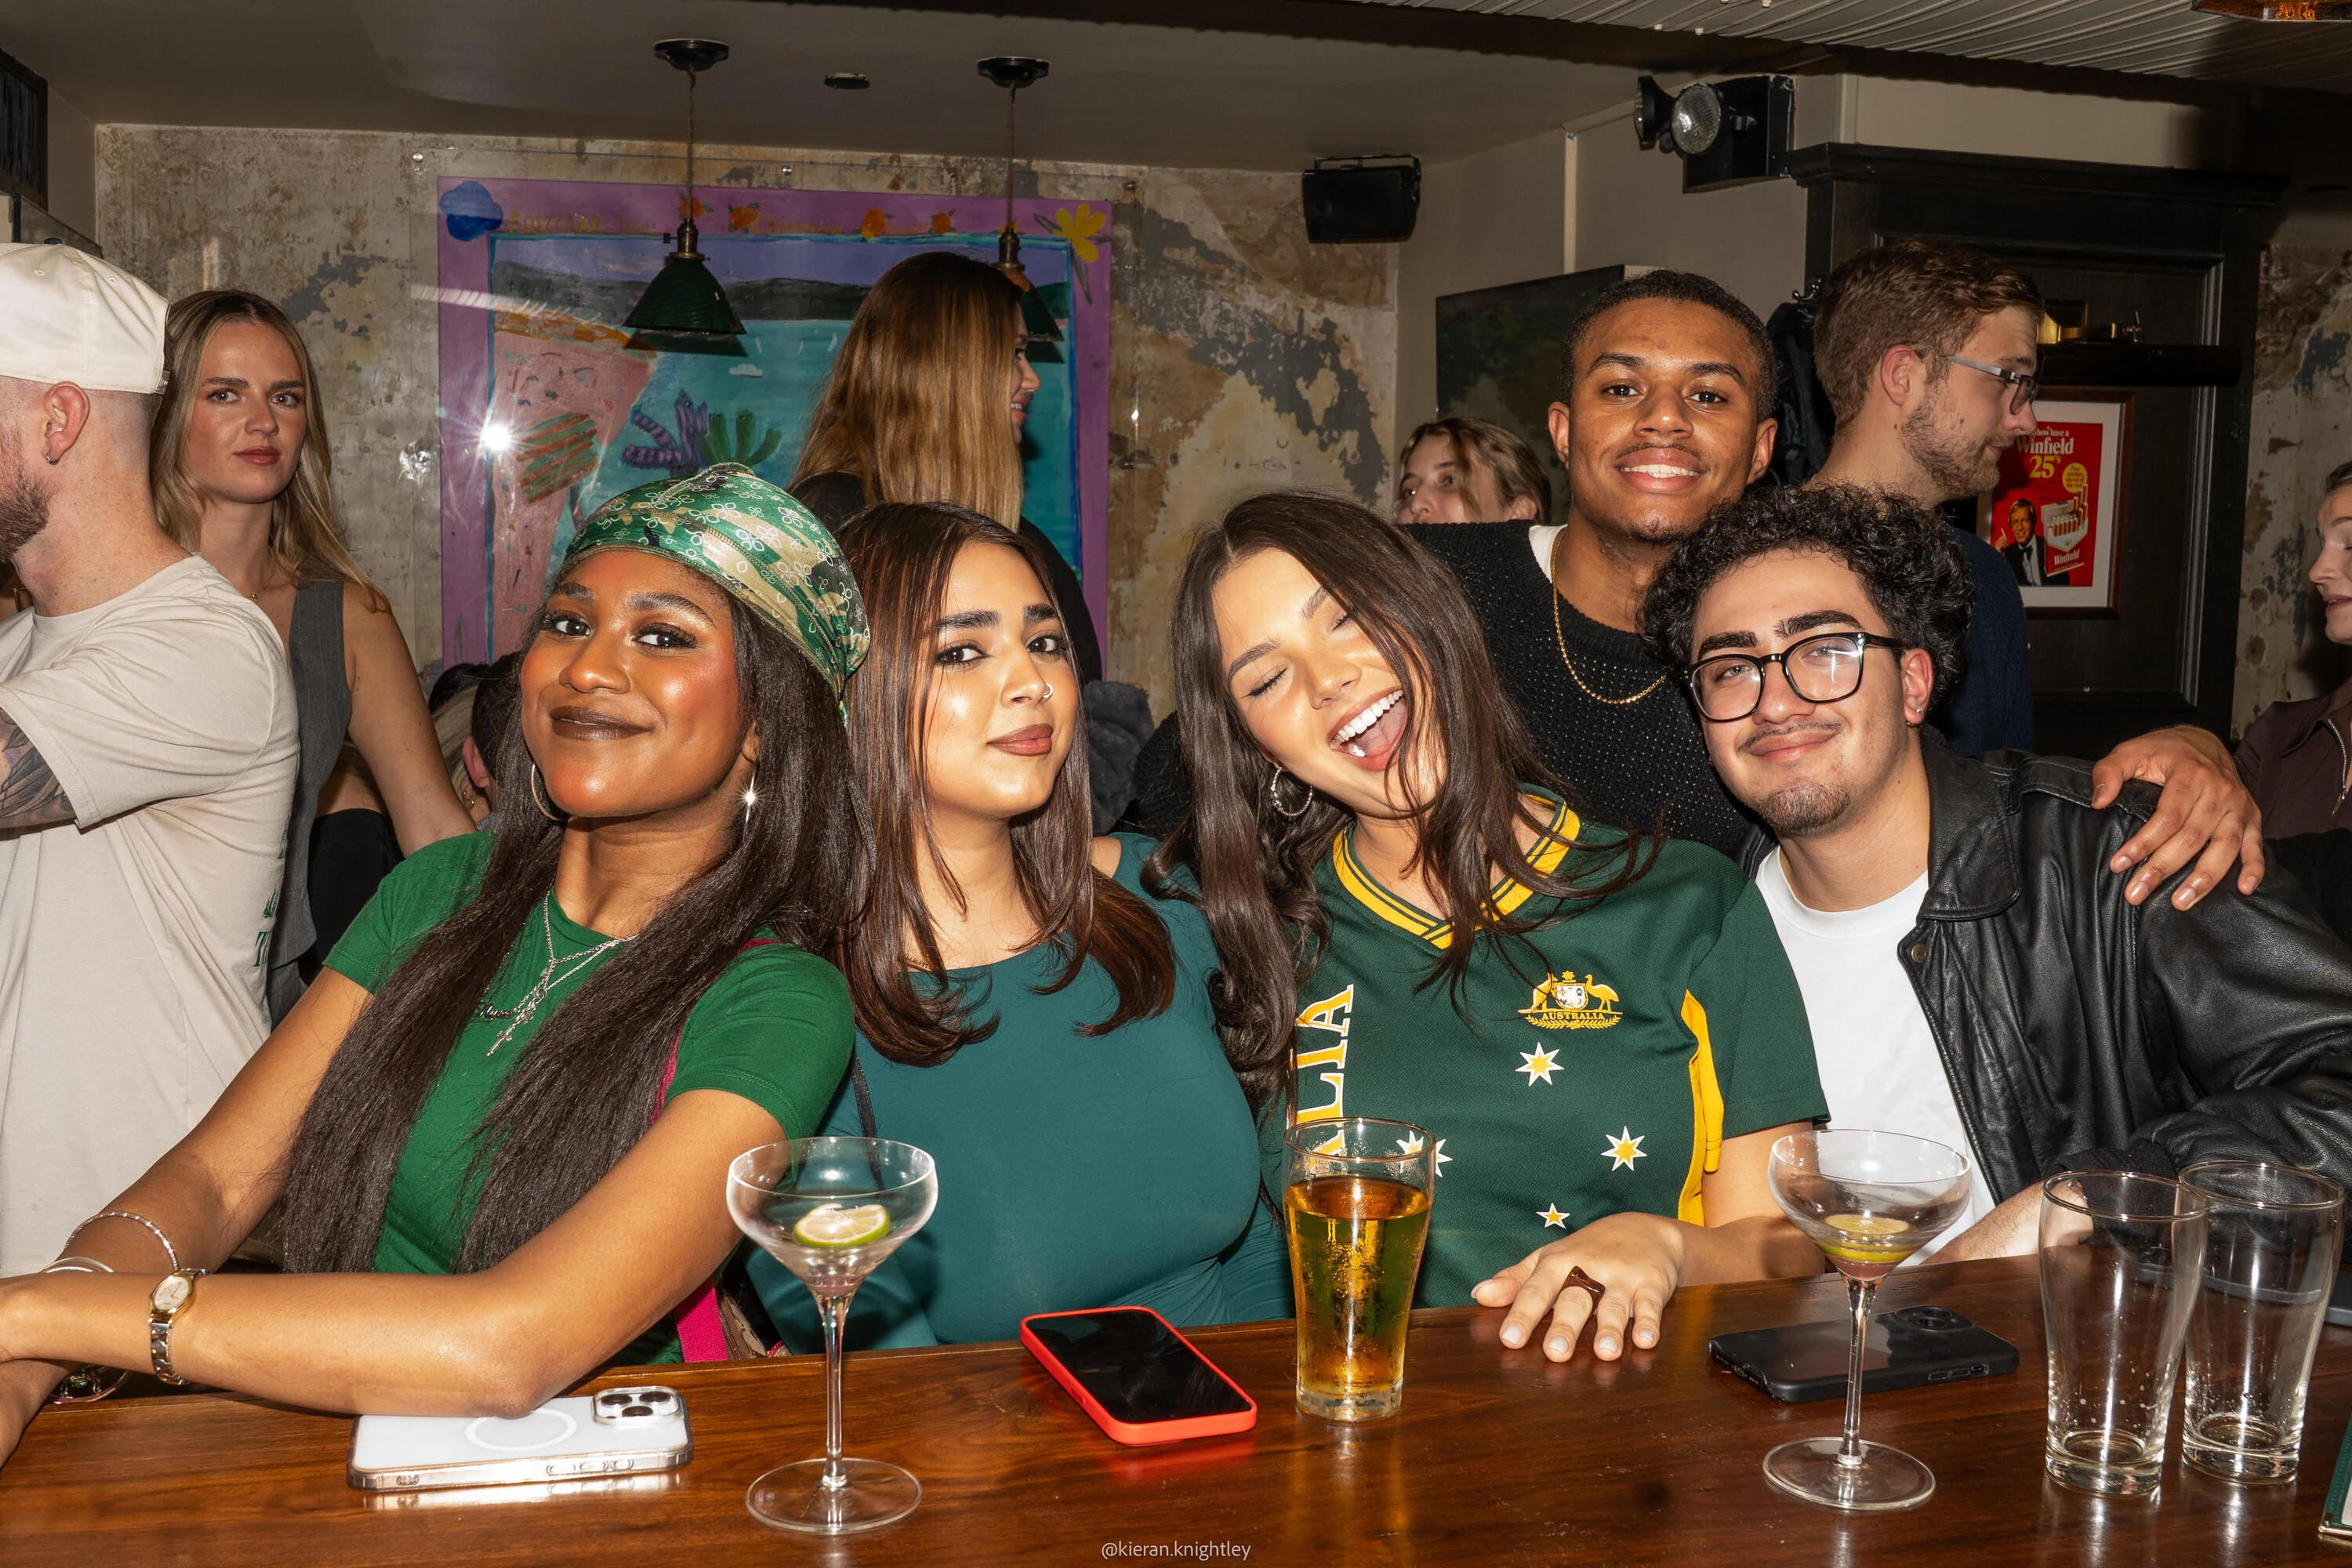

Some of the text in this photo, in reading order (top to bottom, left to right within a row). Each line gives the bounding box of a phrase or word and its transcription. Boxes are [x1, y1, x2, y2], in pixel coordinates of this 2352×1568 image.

[2016, 437, 2074, 455] Winfield
[2029, 455, 2061, 479] 25's
[2054, 549, 2080, 565] Winfield
